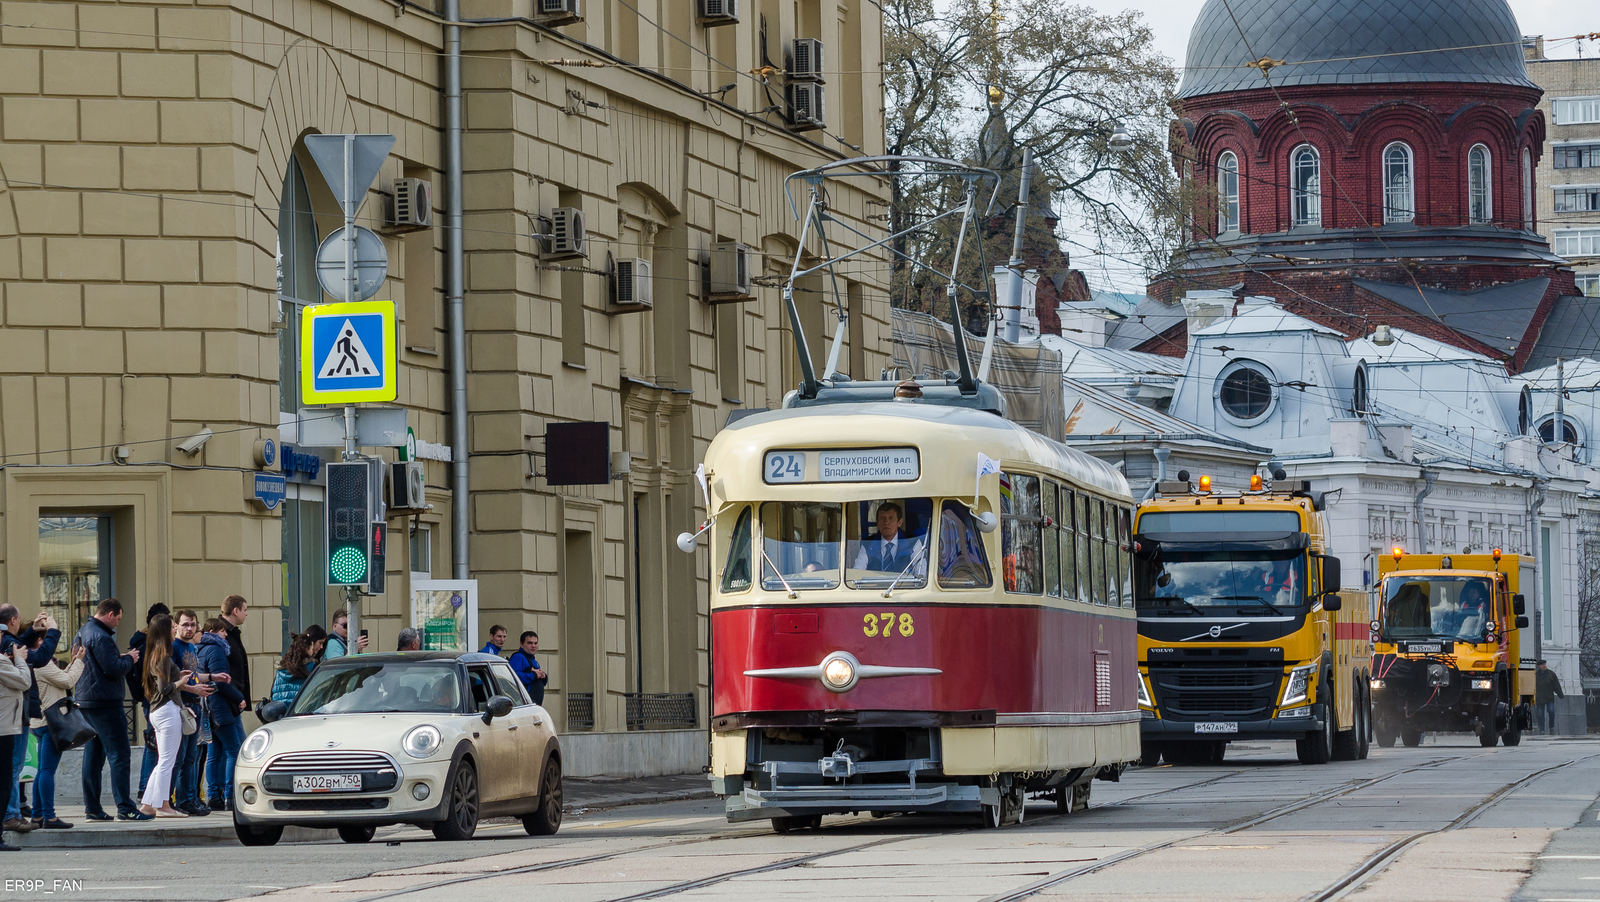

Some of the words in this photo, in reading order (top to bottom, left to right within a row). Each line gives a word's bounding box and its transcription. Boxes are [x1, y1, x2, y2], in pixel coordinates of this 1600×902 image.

[770, 455, 801, 478] 24
[824, 454, 890, 466] СЕРПУХОВСКИЙ
[824, 466, 891, 477] ВЛАДИМИРСКИЙ
[863, 612, 915, 638] 378
[296, 776, 340, 789] А302ВМ
[341, 774, 359, 784] 750
